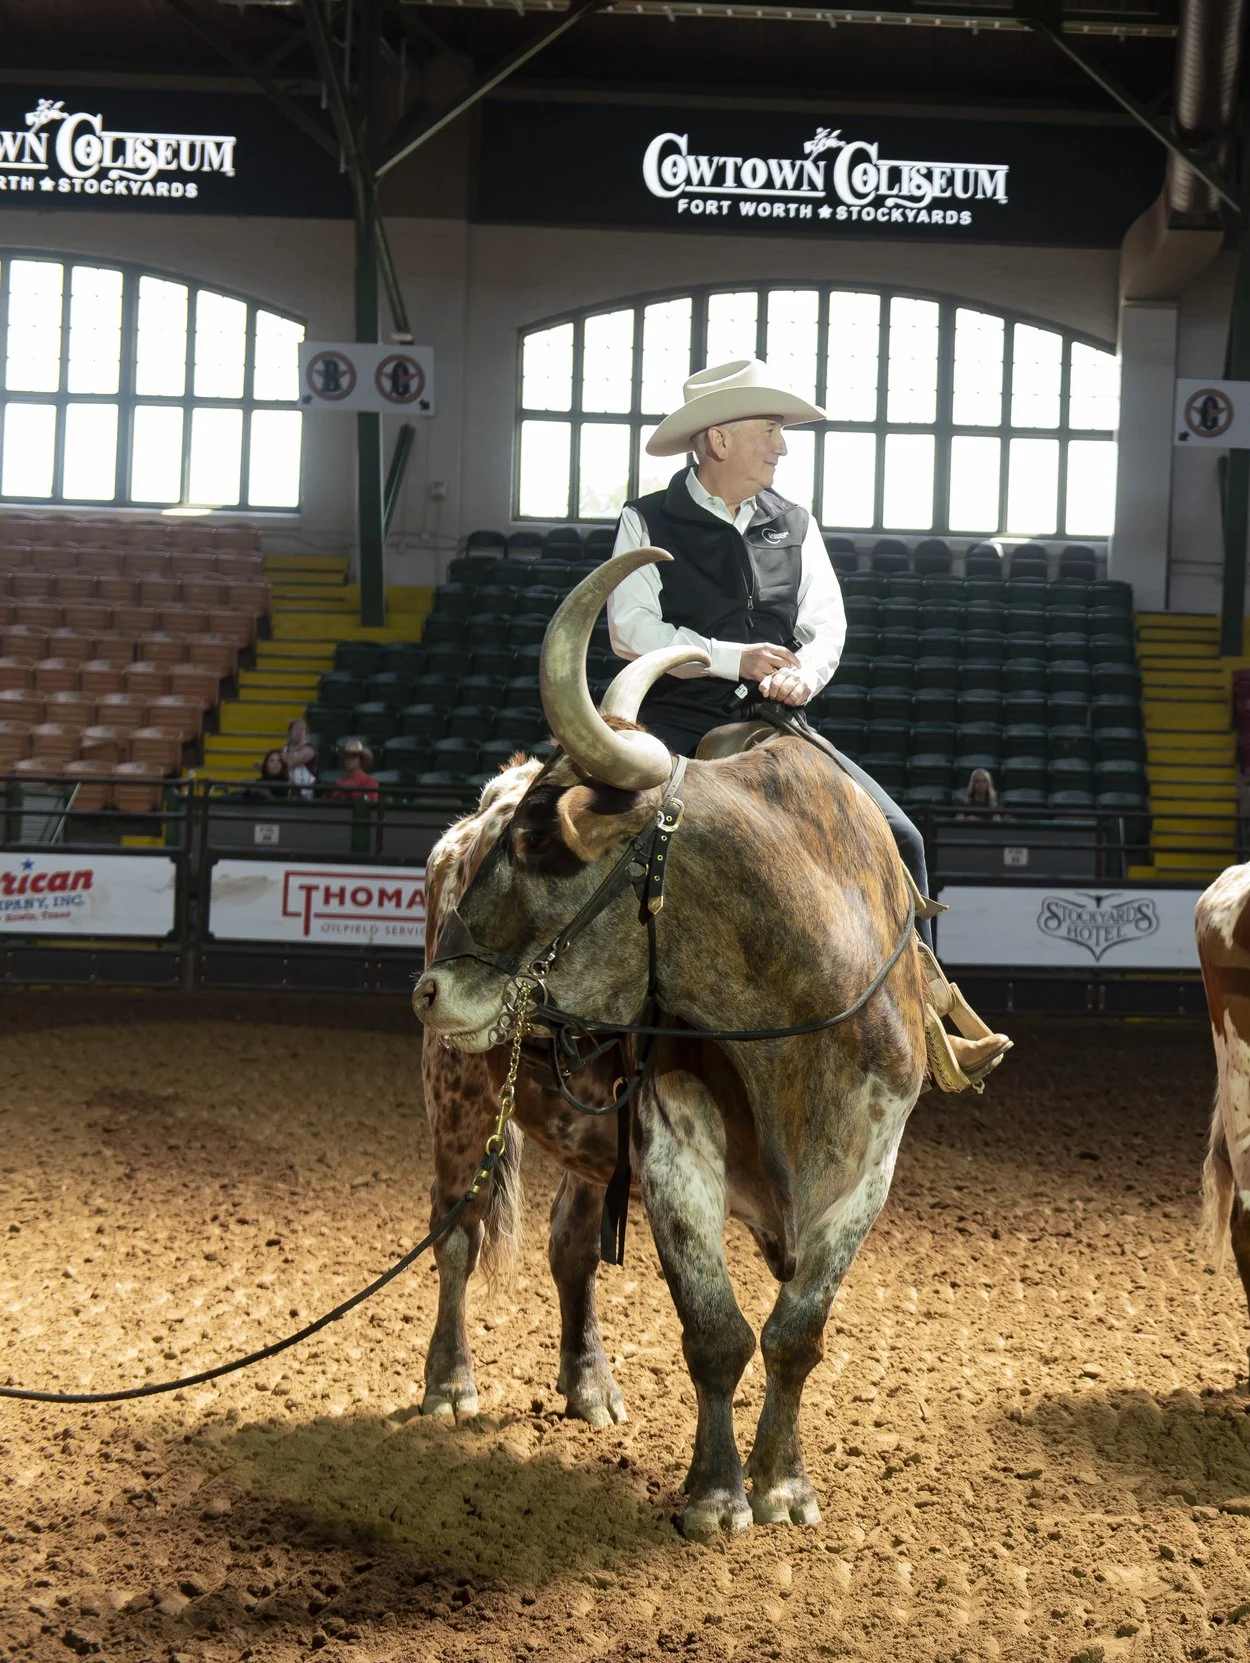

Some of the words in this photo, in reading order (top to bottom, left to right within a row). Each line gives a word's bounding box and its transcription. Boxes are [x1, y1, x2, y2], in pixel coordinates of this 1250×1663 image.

[55, 112, 237, 180] COLISEUM
[643, 132, 826, 199] COWTOWN
[833, 141, 1010, 209] COLISEUM
[57, 177, 199, 199] STOCKYARDS
[677, 198, 732, 216] FORT
[738, 201, 813, 219] WORTH
[835, 205, 972, 226] STOCKYARDS
[0, 869, 94, 895] rican
[298, 884, 426, 937] THOMA
[1044, 901, 1153, 932] STOCKYARDS
[320, 922, 379, 935] OILFIELD
[384, 924, 426, 937] SERVIC
[1067, 924, 1126, 947] HOTEL
